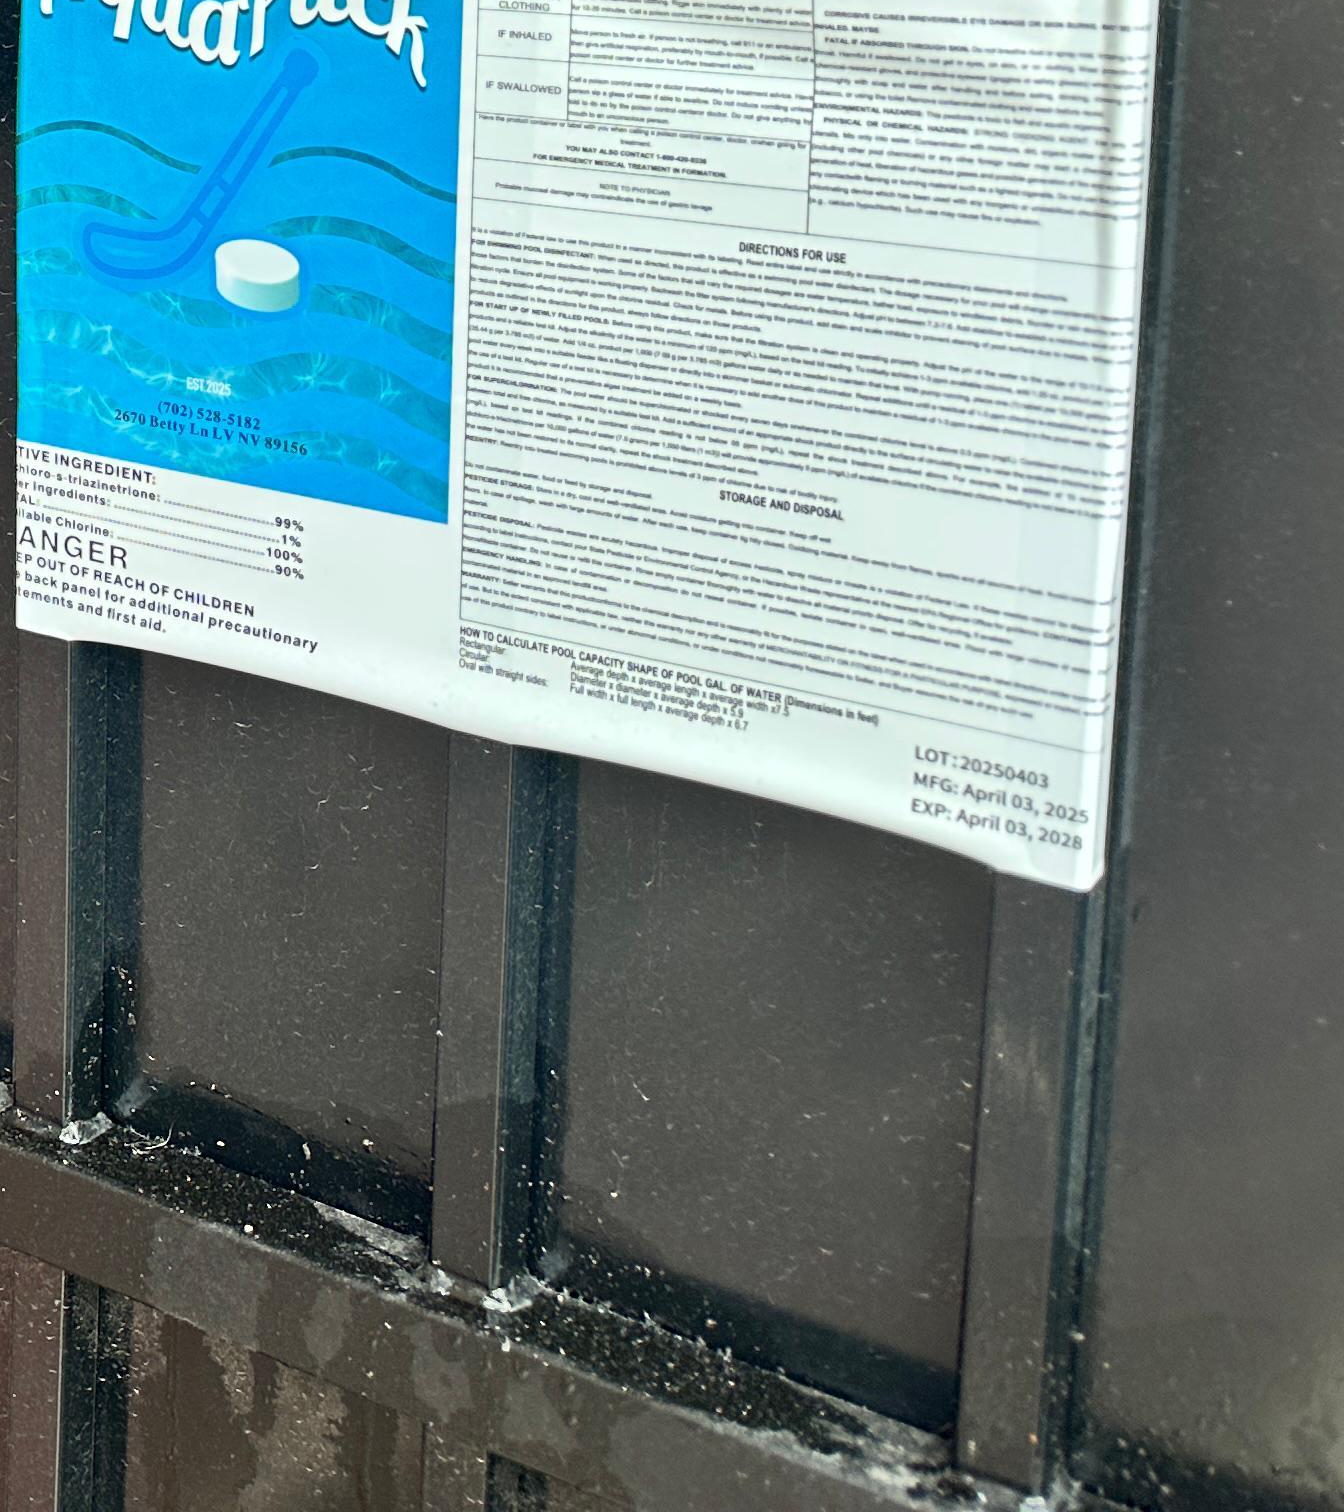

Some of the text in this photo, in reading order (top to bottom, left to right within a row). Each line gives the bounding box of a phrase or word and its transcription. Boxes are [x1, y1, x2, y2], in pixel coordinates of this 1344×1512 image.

[499, 0, 550, 12] CLOTHING
[498, 29, 552, 41] IF INHALED
[486, 80, 494, 89] IF
[497, 81, 562, 95] SWALLOWED
[739, 241, 847, 264] DIRECTIONS FOR USE
[158, 401, 261, 430] (702) 528-5182
[114, 409, 308, 456] 2670 Betty Ln LV NV 89156
[16, 445, 156, 486] TIVE INGREDIENT:
[719, 490, 845, 521] STORAGE AND DISPOSAL
[274, 516, 304, 532] 99%
[266, 547, 304, 564] 100%
[281, 534, 302, 548] 1%
[37, 557, 66, 573] OUT
[70, 564, 89, 578] OF
[94, 570, 145, 592] REACH
[149, 582, 170, 597] OF
[174, 588, 255, 617] CHILDREN
[274, 564, 305, 580] 90%
[16, 586, 167, 634] tements and first aid.
[25, 570, 58, 589] back
[62, 581, 101, 599] panel
[105, 589, 125, 604] for
[129, 597, 204, 624] additional
[208, 616, 319, 654] precautionary
[459, 626, 480, 639] HOW
[482, 630, 494, 642] TO
[496, 633, 549, 654] CALCULATE
[552, 645, 576, 660] POOL
[579, 651, 625, 670] CAPACITY
[627, 661, 658, 677] SHAPE
[661, 668, 674, 679] OF
[676, 671, 703, 687] POOL
[731, 683, 744, 694] OF
[746, 686, 782, 703] WATER
[913, 772, 1089, 824] MFG: April 03, 2025
[911, 798, 1083, 850] EXP: April 03, 2028
